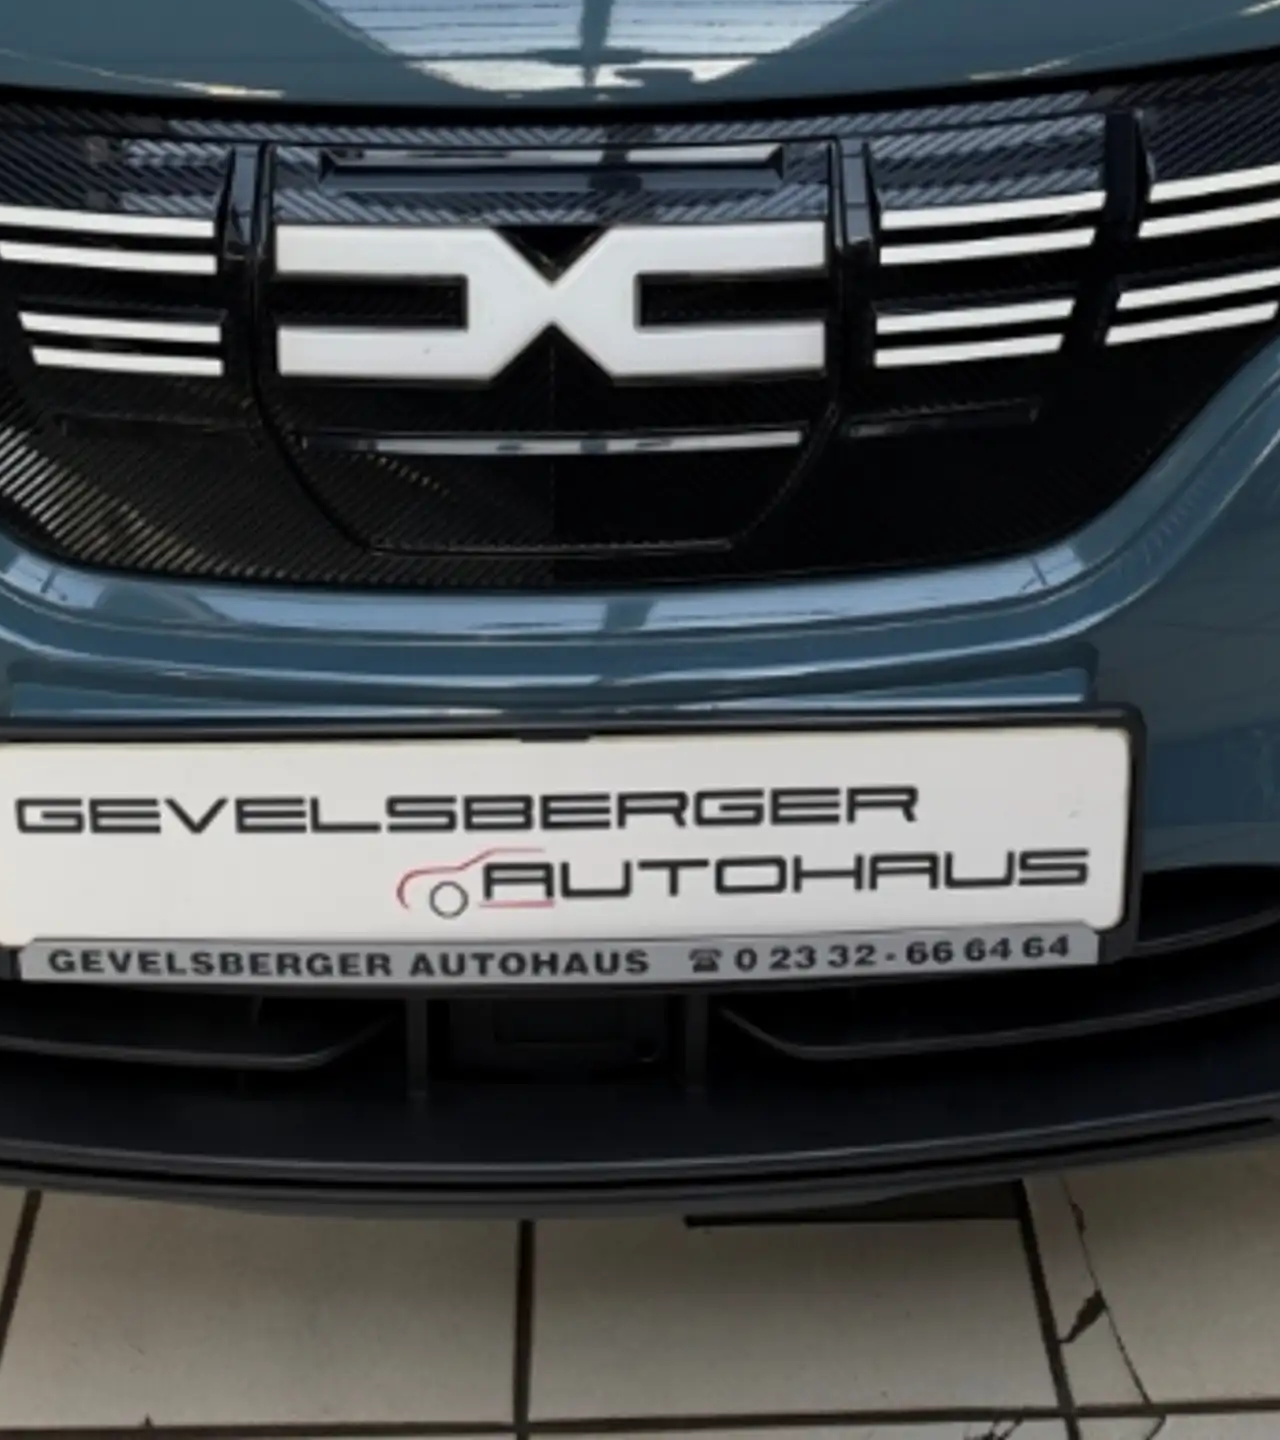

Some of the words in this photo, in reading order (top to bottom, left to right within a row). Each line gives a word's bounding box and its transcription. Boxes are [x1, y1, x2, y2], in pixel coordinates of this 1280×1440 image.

[15, 785, 920, 834] GEVELSBERGER
[482, 848, 1090, 900] AUTOHAUS
[48, 948, 393, 977] GEVELSBERGER
[409, 948, 650, 977] AUTOHAUS
